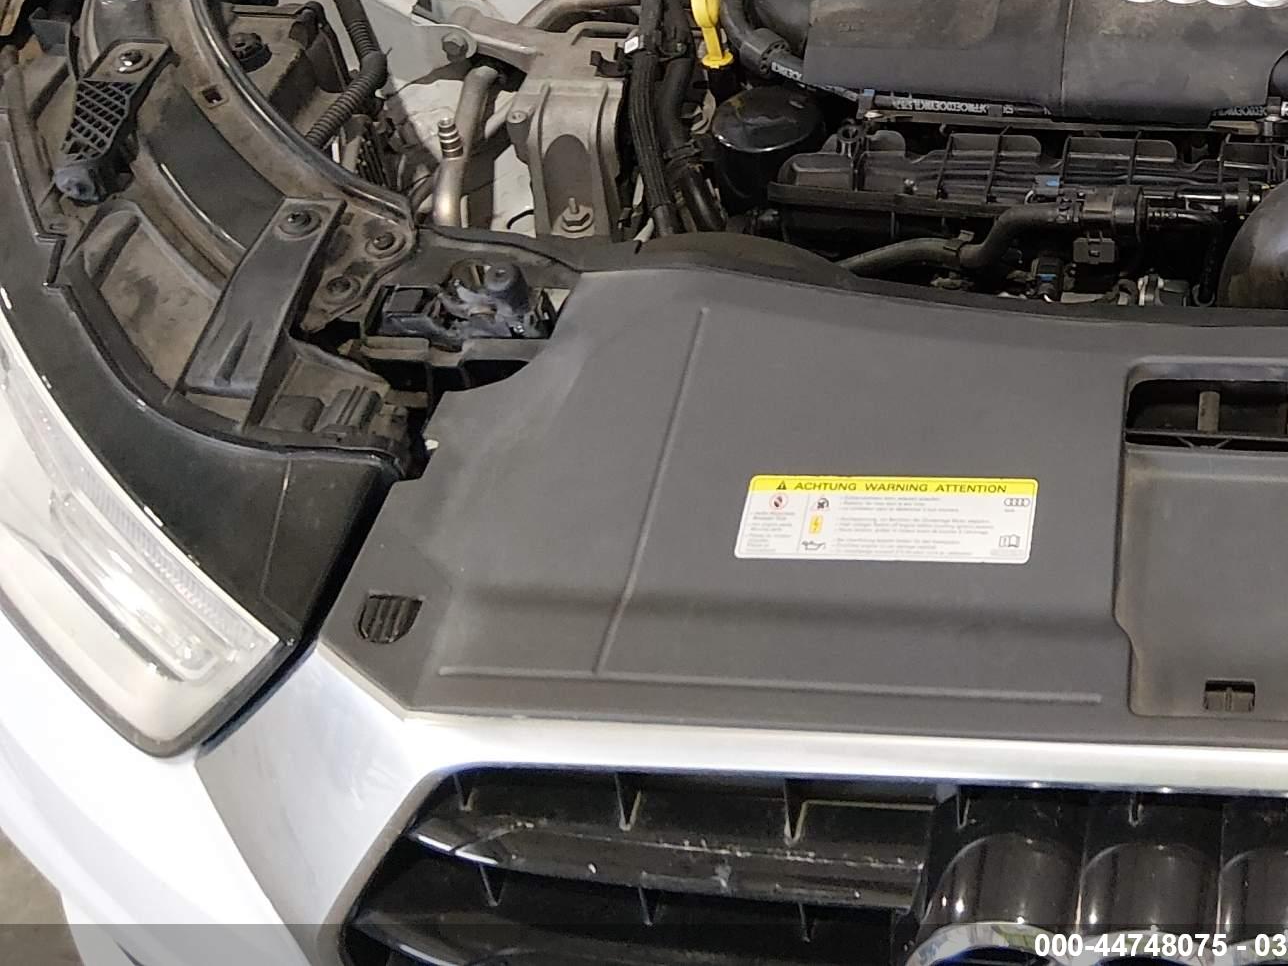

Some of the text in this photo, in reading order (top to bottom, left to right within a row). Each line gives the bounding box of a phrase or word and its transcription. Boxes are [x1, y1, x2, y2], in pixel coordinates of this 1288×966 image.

[794, 482, 1008, 493] ACHTUNG WARNING ATTENTION
